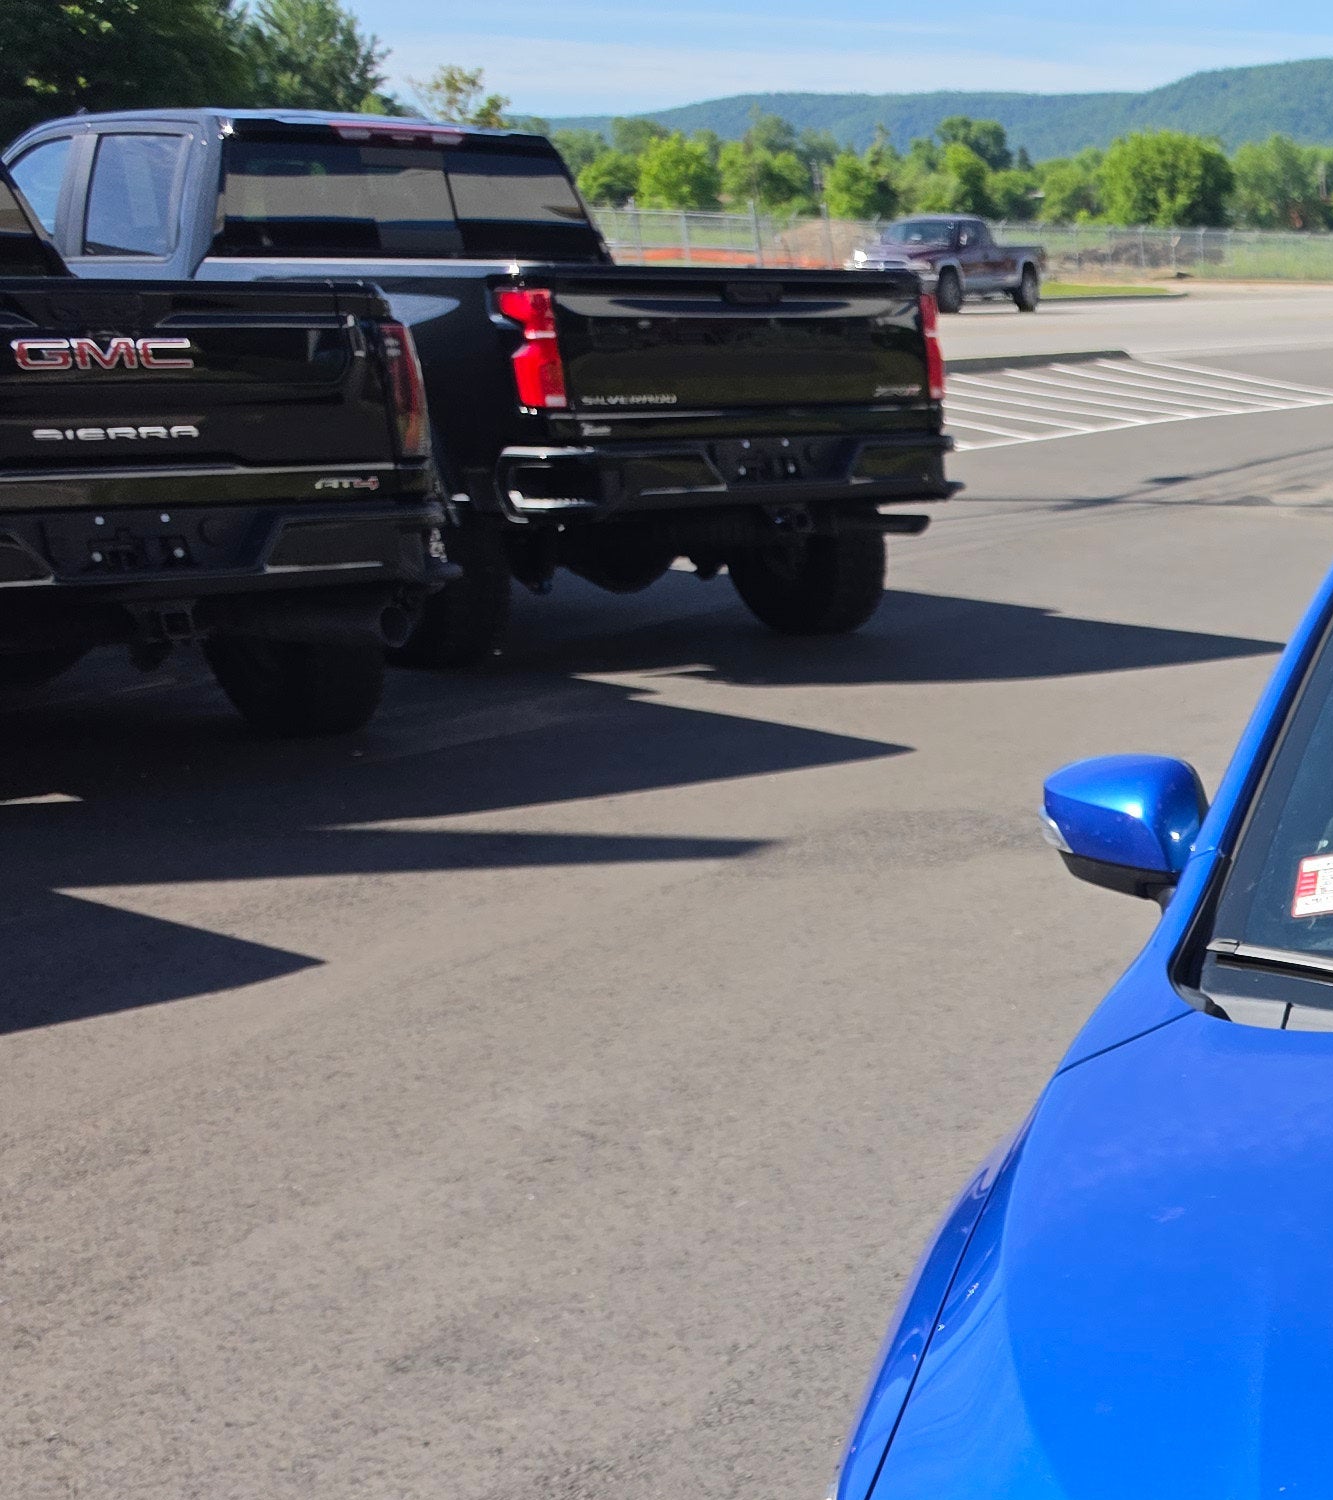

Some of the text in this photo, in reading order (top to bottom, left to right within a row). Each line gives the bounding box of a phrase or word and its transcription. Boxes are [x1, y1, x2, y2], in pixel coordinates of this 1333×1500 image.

[11, 337, 194, 371] GMC
[32, 425, 200, 440] SIERRA
[315, 476, 379, 490] AT4
